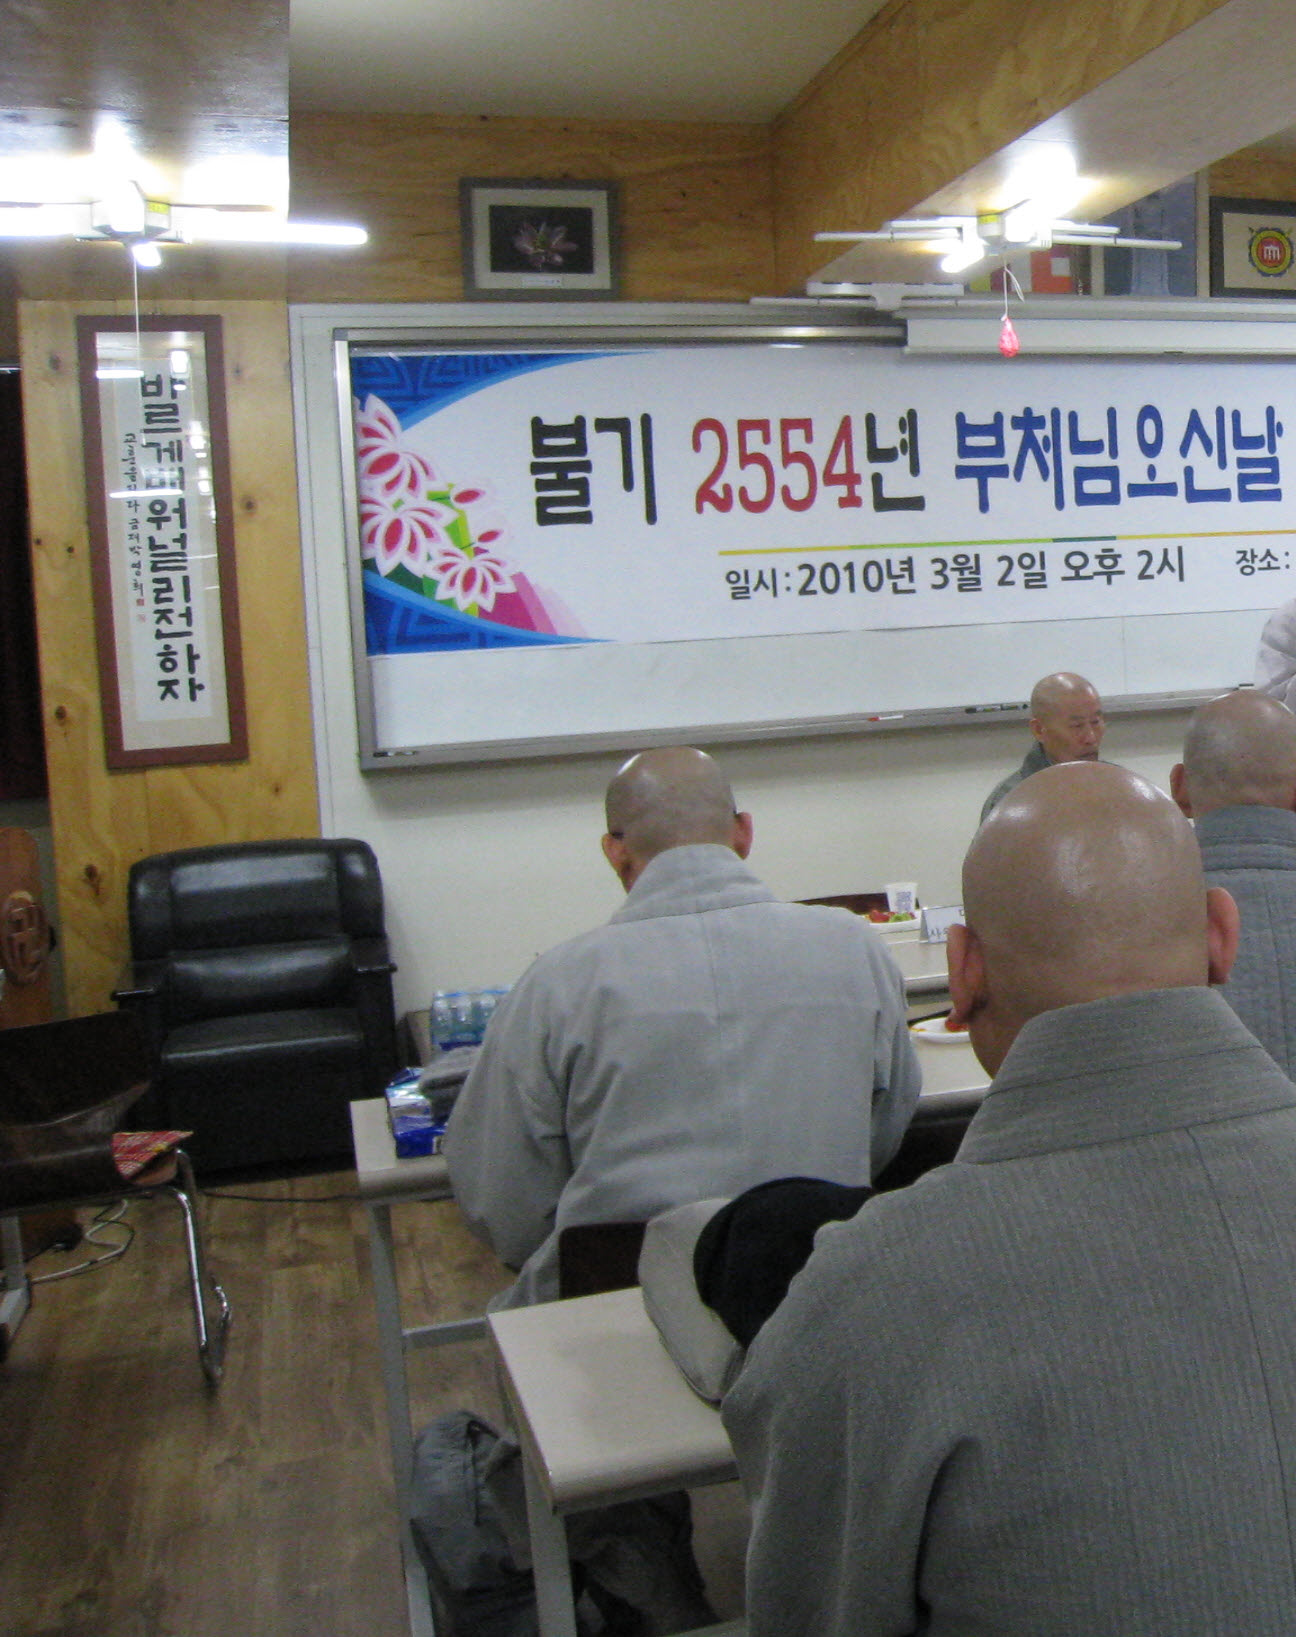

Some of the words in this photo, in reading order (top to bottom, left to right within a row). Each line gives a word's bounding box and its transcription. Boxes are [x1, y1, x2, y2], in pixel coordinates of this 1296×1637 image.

[530, 413, 657, 526] 불기
[692, 408, 926, 514] 2554년
[955, 404, 1284, 513] 부처님오신날
[929, 553, 982, 592] 3월
[997, 551, 1048, 589] 2일
[1060, 547, 1126, 585] 오후
[1137, 546, 1185, 582] 2시
